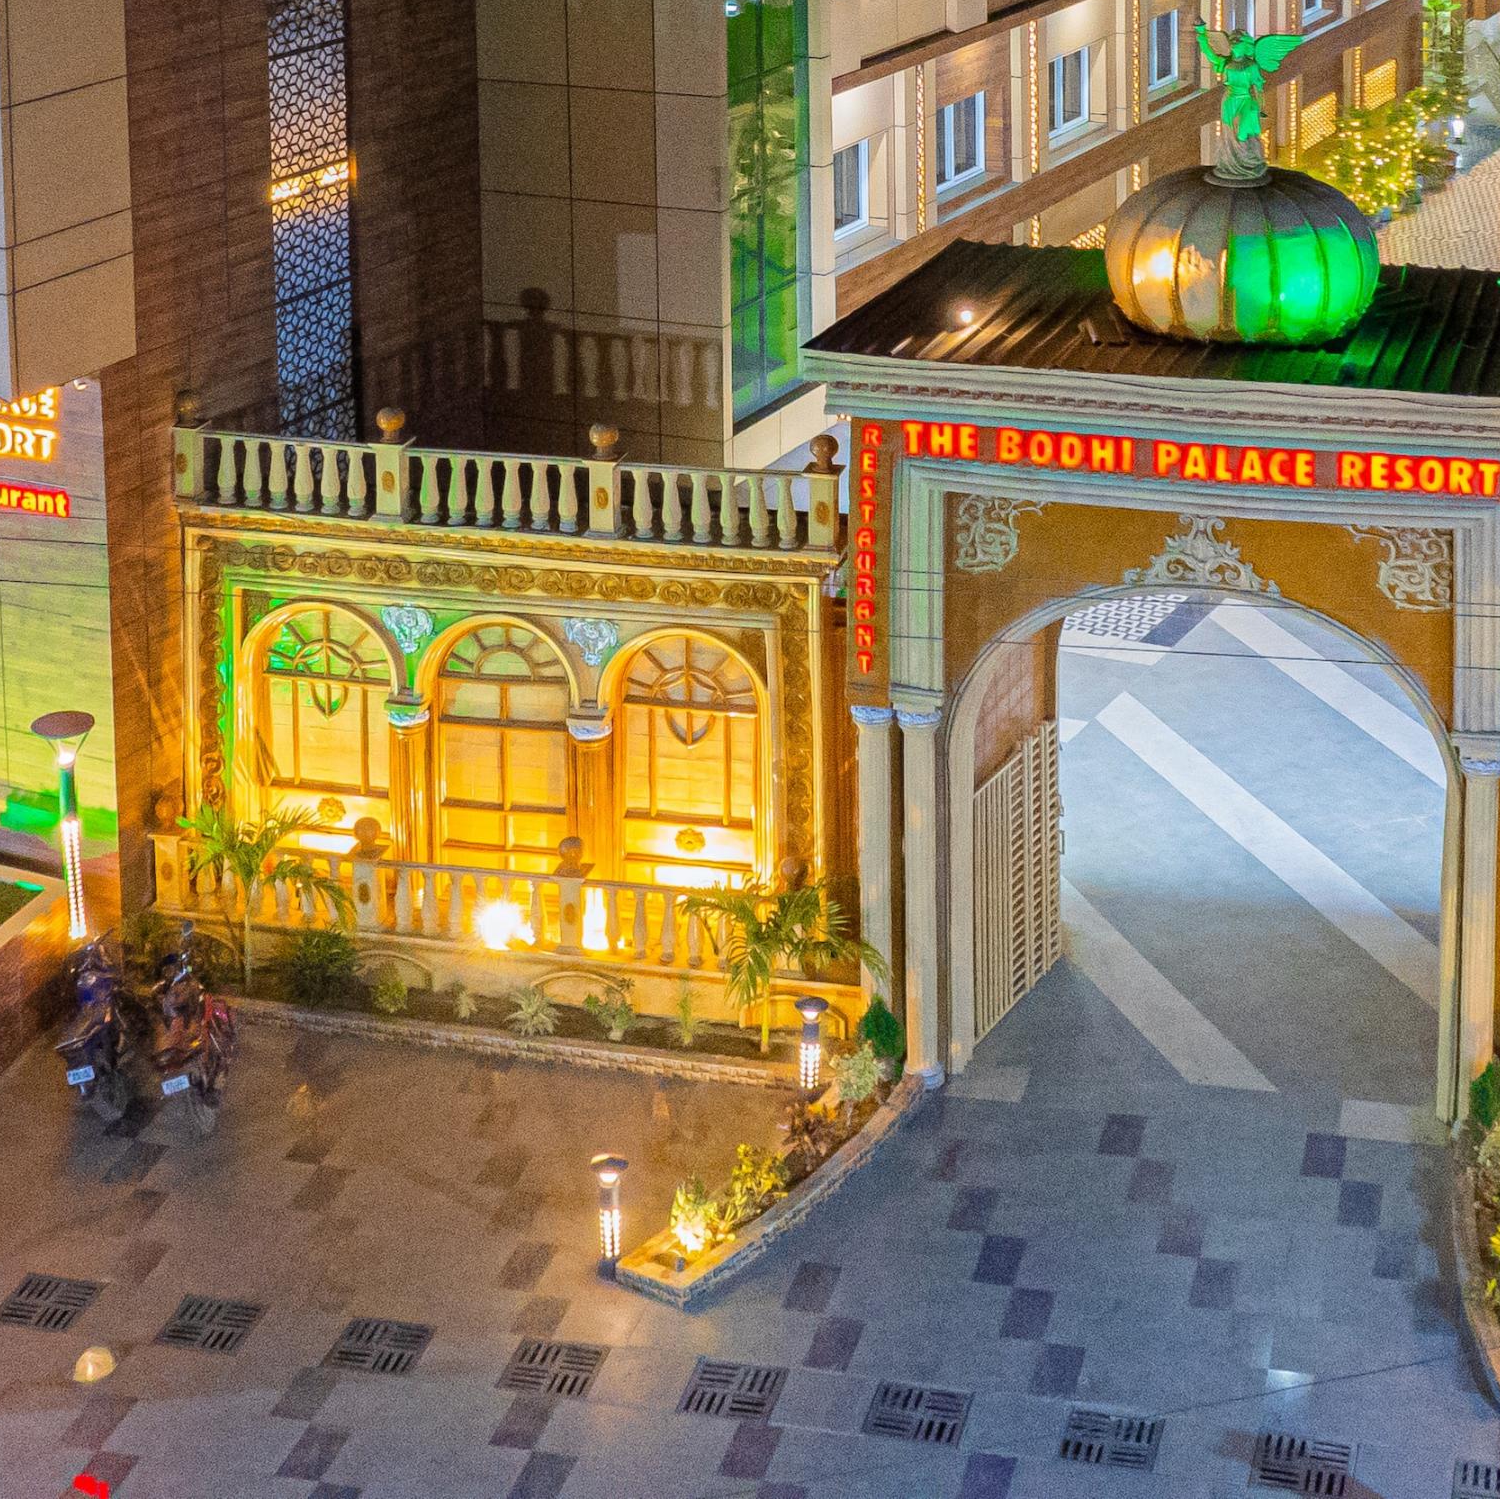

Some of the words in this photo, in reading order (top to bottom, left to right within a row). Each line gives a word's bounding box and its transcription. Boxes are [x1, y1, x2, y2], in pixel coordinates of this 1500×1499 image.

[902, 421, 976, 458] THE
[1000, 429, 1132, 472] BODHI
[1157, 441, 1315, 487] PALACE
[1340, 453, 1500, 496] RESORT
[855, 423, 883, 675] RESTAURANT
